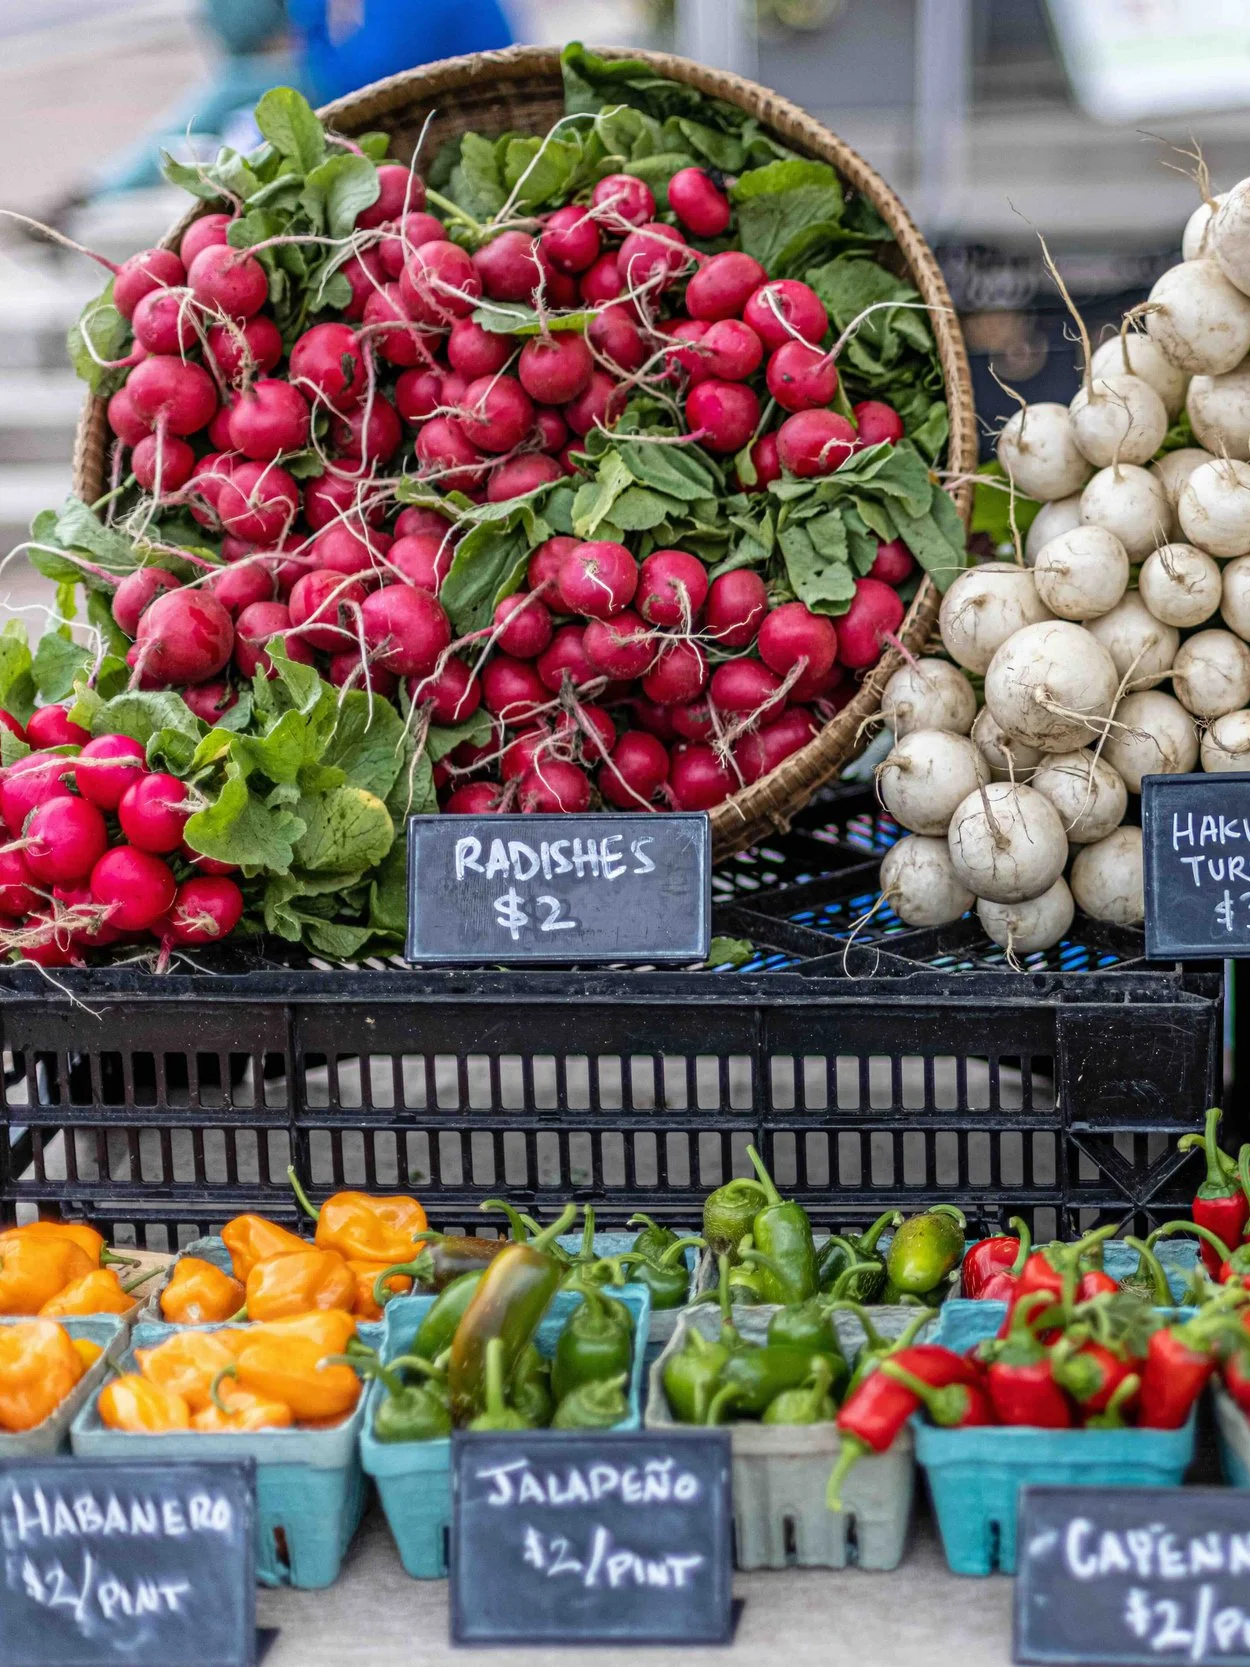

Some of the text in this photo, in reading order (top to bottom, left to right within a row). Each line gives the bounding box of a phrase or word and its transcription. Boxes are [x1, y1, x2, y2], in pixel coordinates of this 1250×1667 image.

[455, 834, 656, 881] RADISHES
[493, 886, 576, 940] $2
[476, 1457, 699, 1506] JALAPEÑO
[11, 1485, 232, 1541] HABANERO
[523, 1525, 704, 1587] $2/PINT
[22, 1548, 192, 1622] $2/PINT
